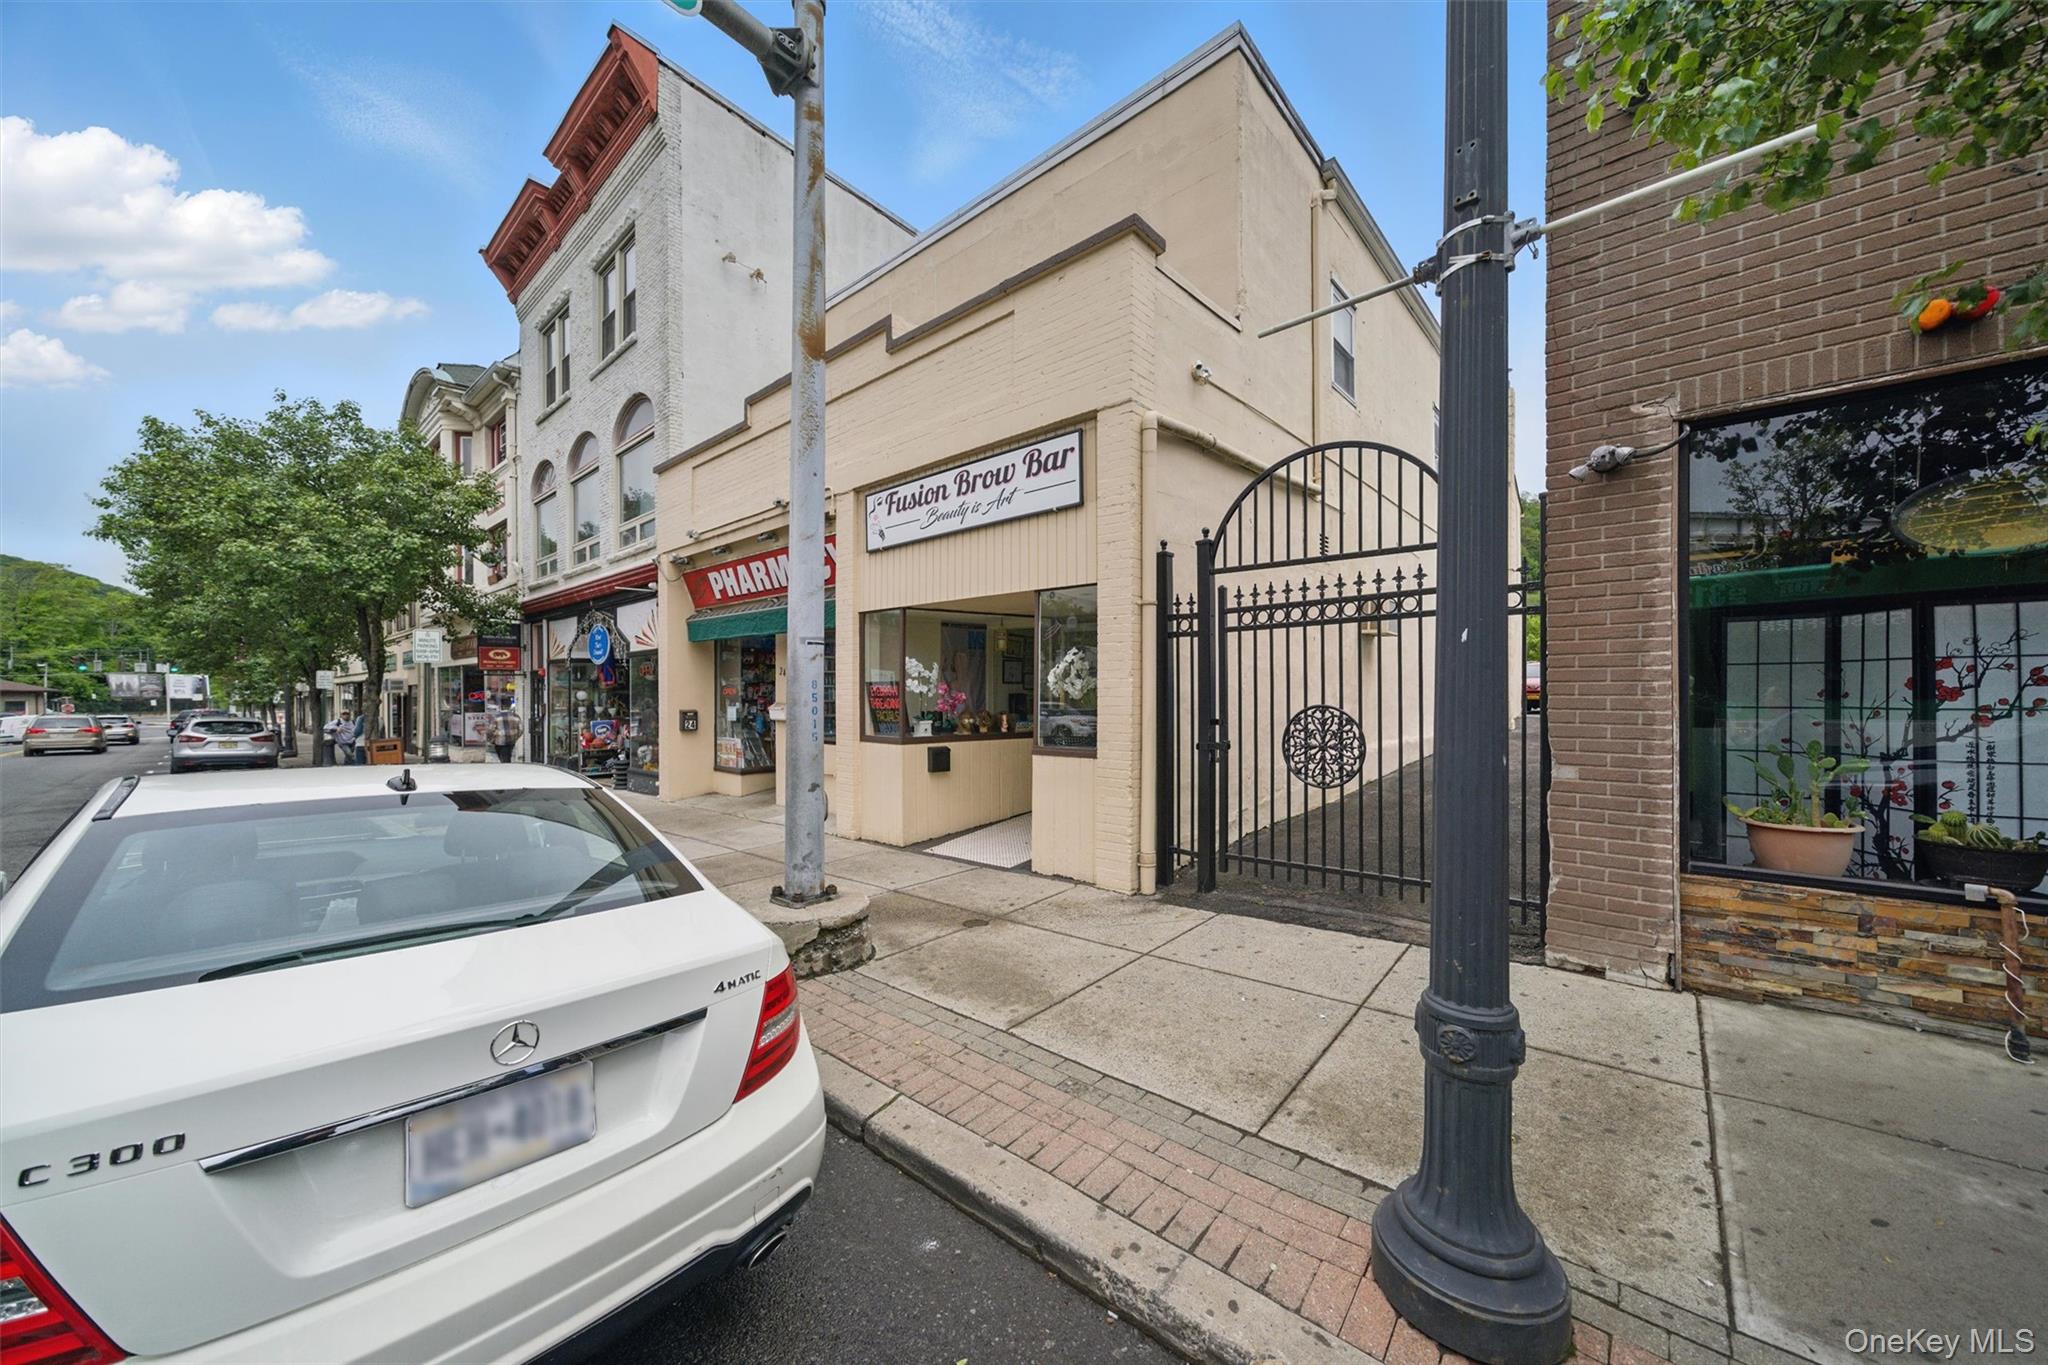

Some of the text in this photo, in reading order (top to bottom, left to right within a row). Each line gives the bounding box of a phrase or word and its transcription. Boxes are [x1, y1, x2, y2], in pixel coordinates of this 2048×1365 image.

[884, 446, 1076, 516] Fusion Brow Bar
[919, 486, 1022, 530] Beauty is Art
[18, 1132, 187, 1188] C 300
